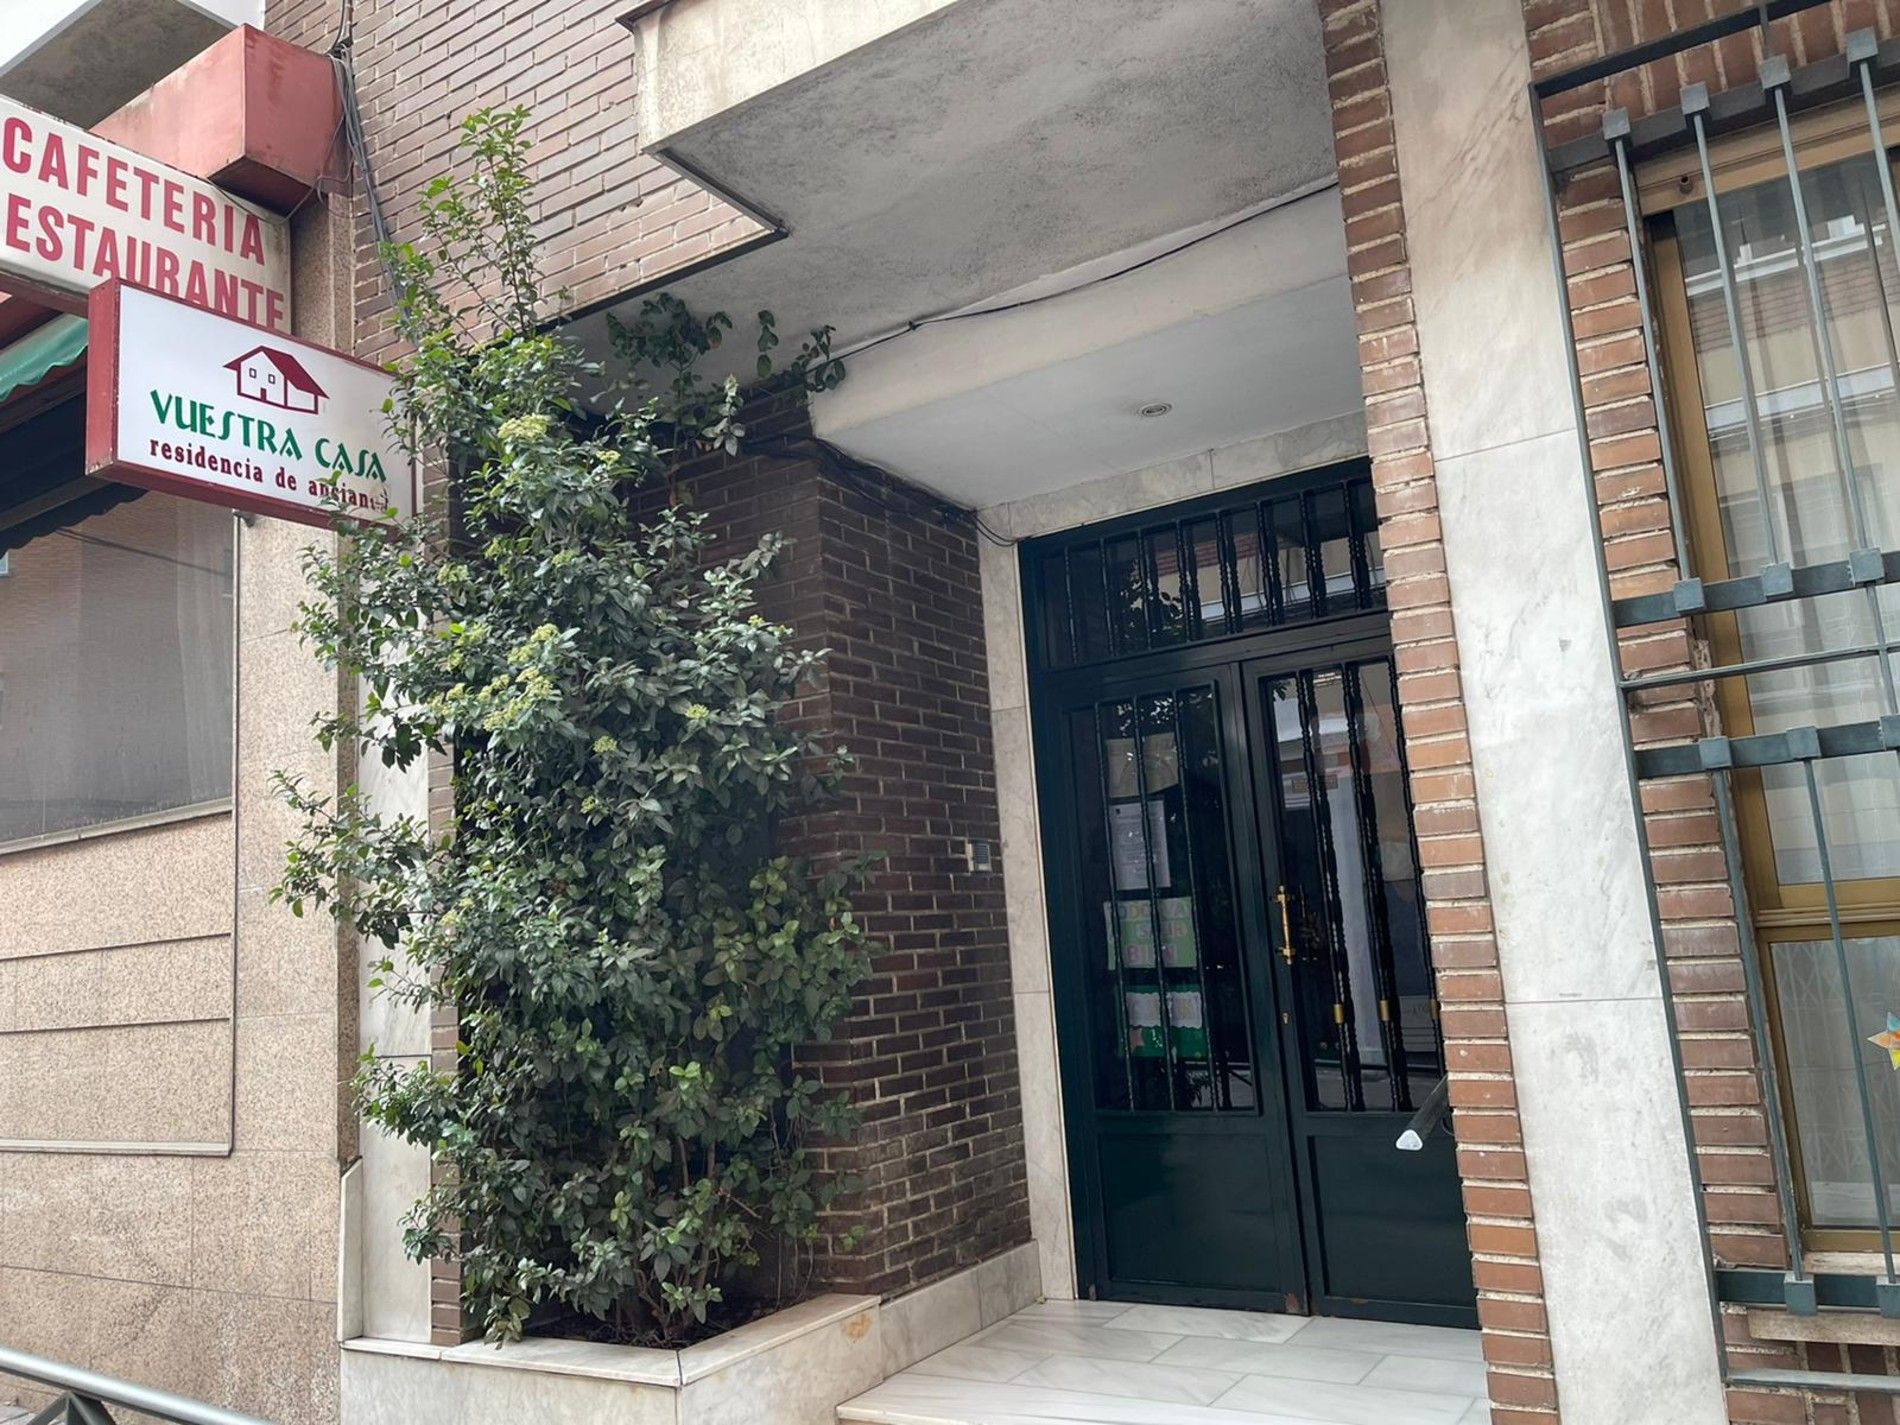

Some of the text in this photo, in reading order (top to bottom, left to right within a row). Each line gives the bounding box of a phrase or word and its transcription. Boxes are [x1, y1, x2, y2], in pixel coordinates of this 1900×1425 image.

[3, 117, 265, 266] CAFETERIA
[150, 389, 387, 482] VUESTRA CASA
[150, 439, 263, 483] residencia
[275, 466, 297, 490] de
